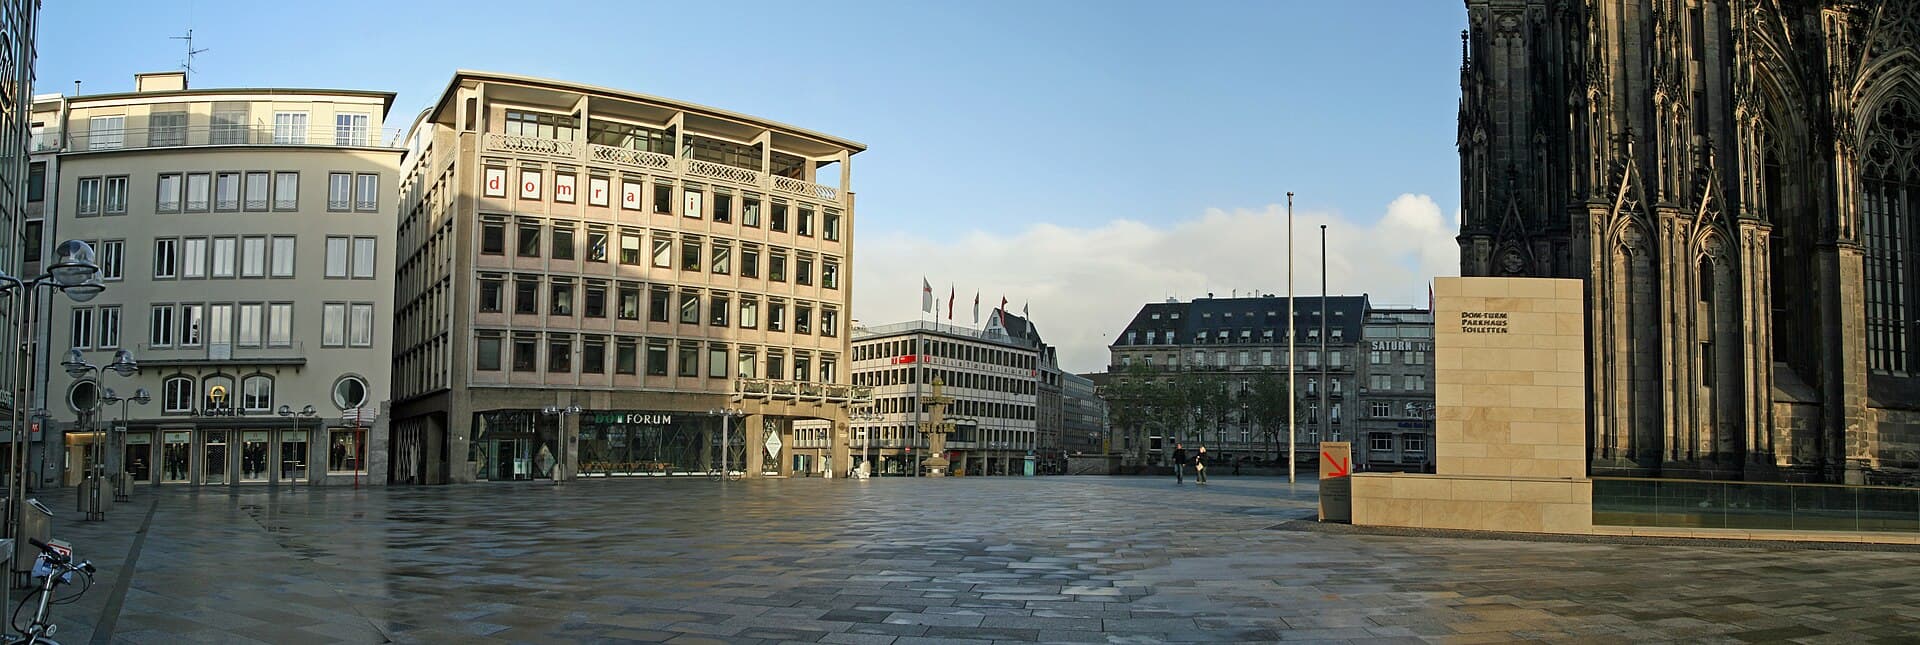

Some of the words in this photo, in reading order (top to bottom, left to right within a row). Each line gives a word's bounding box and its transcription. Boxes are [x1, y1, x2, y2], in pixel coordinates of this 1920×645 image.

[1461, 326, 1508, 334] TOILETTEN
[1371, 341, 1412, 351] SATURN
[191, 407, 246, 417] AIGNER
[626, 413, 671, 425] FORUM
